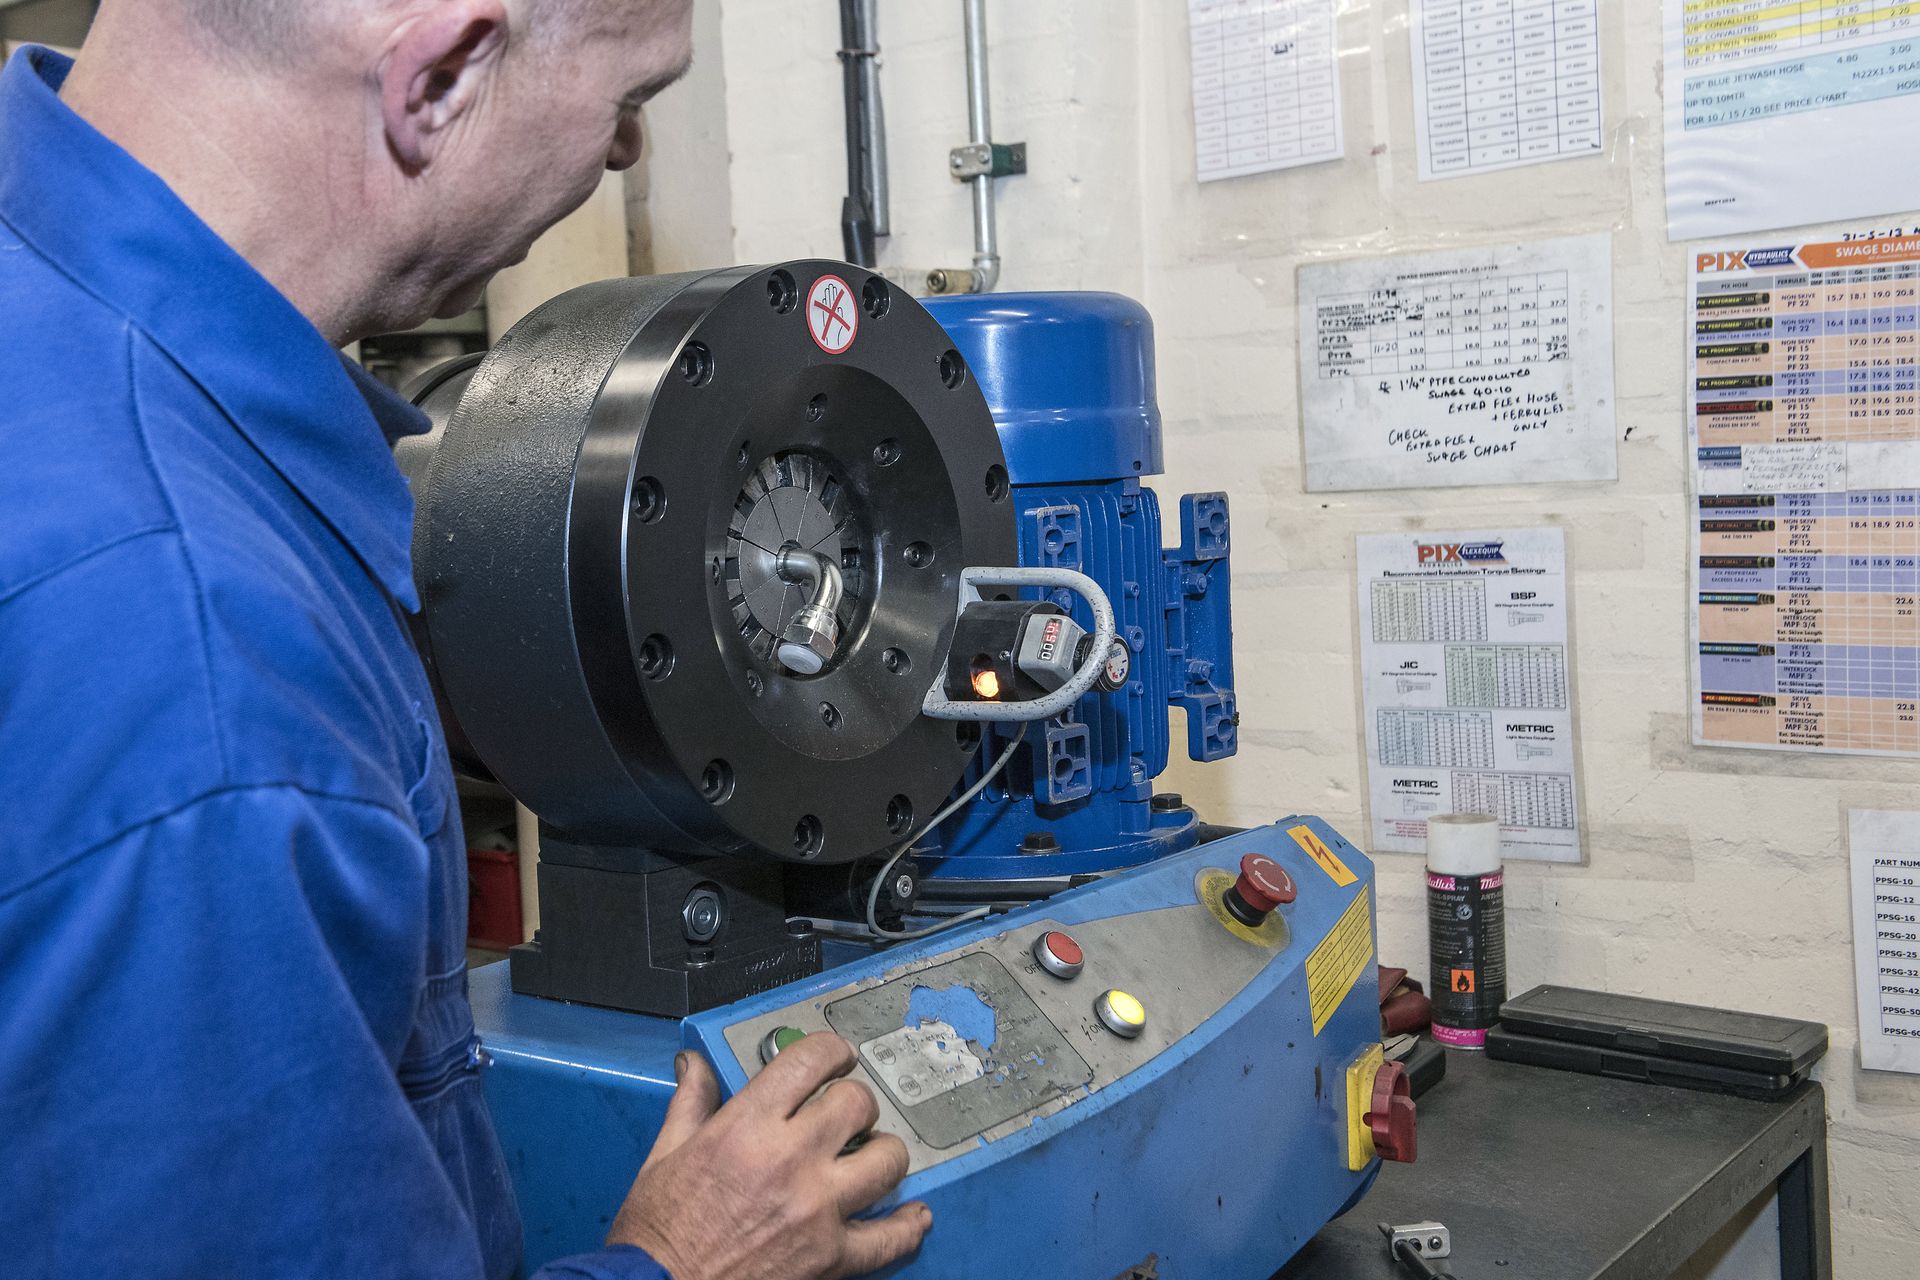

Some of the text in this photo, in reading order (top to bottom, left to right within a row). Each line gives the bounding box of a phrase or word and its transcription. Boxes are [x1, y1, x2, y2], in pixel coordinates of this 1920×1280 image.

[1708, 76, 1729, 87] BLUE
[1734, 69, 1776, 84] JETWASH
[1779, 63, 1805, 74] HOSE
[1686, 91, 1745, 108] UP TO 10MTR
[1686, 116, 1704, 126] FOR
[1708, 114, 1718, 123] 10
[1729, 110, 1739, 119] 15
[1749, 107, 1761, 115] 20
[1763, 102, 1780, 113] SEE
[1784, 98, 1812, 110] PRICE
[1815, 91, 1847, 105] CHART
[1836, 243, 1879, 258] SWAGE
[1748, 249, 1789, 262] HYDRAULICS
[1697, 249, 1747, 273] PIX
[1850, 292, 1866, 300] 18.1
[1873, 290, 1891, 298] 19.0
[1896, 289, 1914, 297] 20.8
[1827, 294, 1844, 302] 15.7
[1872, 316, 1890, 325] 19.5
[1895, 315, 1914, 323] 21.2
[1827, 320, 1844, 328] 16.4
[1850, 338, 1867, 346] 17.0
[1873, 337, 1890, 345] 17.6
[1896, 357, 1914, 365] 18.4
[1850, 372, 1867, 380] 17.8
[1895, 370, 1914, 378] 21.0
[1429, 377, 1455, 387] PTFE
[1850, 385, 1867, 393] 18.4
[1895, 383, 1914, 391] 20.2
[1503, 404, 1564, 421] FERRULES
[1895, 408, 1914, 416] 20.0
[1513, 420, 1548, 432] ONLY
[1388, 428, 1429, 446] CHECK
[1474, 441, 1517, 457] CHART
[1418, 543, 1462, 563] PIX
[1438, 569, 1480, 577] Installation
[1481, 568, 1510, 576] Torque
[1510, 567, 1546, 575] Settings
[1510, 592, 1537, 600] BSP
[1802, 621, 1816, 629] 3/4
[1399, 661, 1419, 669] JIC
[1897, 703, 1915, 711] 22.8
[1506, 724, 1555, 734] METRIC
[1393, 779, 1438, 789] METRIC
[1875, 877, 1913, 885] PPSG-10
[1876, 895, 1914, 903] PPSG-12
[1877, 913, 1915, 921] PPSG-16
[1878, 931, 1916, 940] PPSG-20
[1879, 949, 1917, 958] PPSG-25
[1024, 962, 1041, 975] OFF
[1880, 967, 1918, 976] PPSG-32
[1881, 985, 1920, 994] PPSG-42
[1882, 1006, 1920, 1015] PPSG-50
[1089, 1022, 1104, 1033] ON
